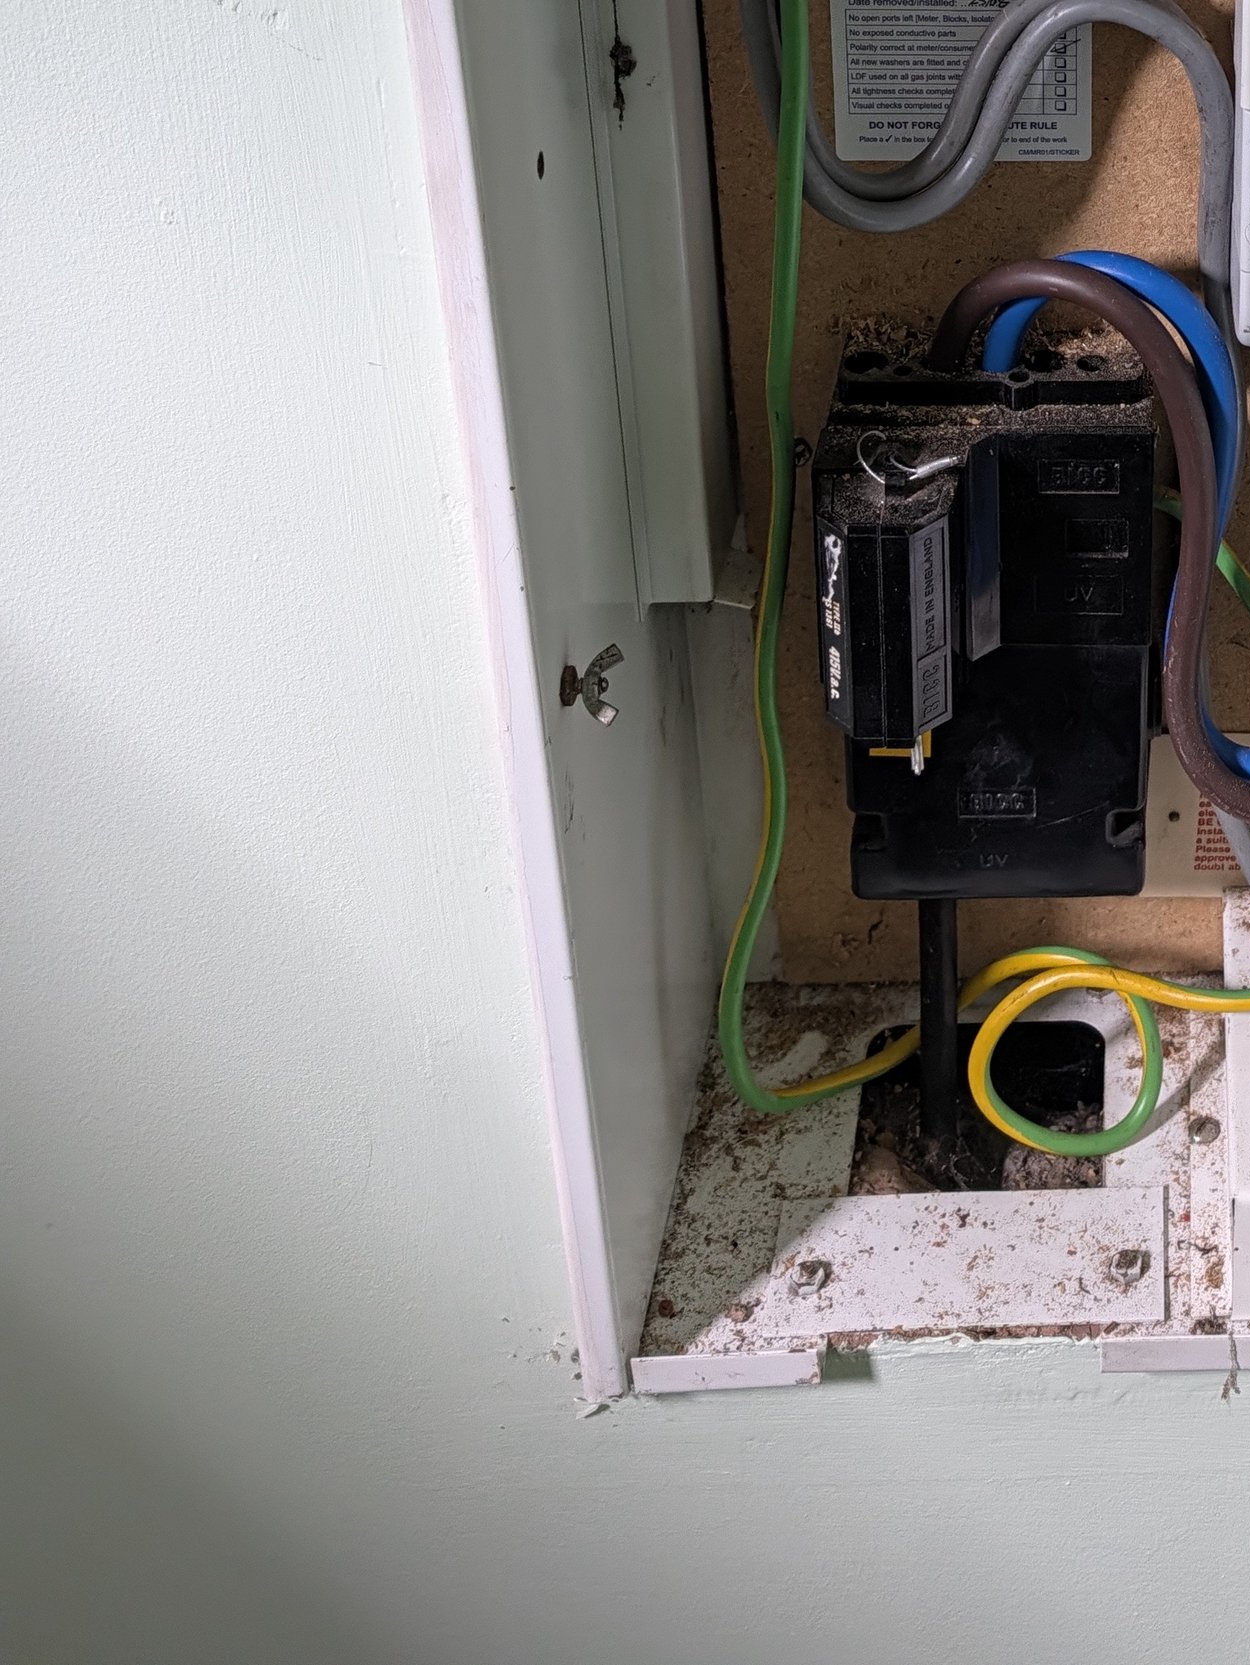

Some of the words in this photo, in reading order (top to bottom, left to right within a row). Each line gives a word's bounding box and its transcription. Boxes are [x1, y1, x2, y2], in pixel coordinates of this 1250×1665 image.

[849, 14, 859, 22] No
[861, 15, 880, 24] open
[882, 15, 901, 24] ports
[903, 14, 913, 22] left
[862, 30, 893, 38] exposed
[938, 30, 957, 38] parts
[850, 44, 878, 53] Polarity
[880, 44, 905, 52] correct
[879, 58, 910, 66] washers
[926, 58, 944, 66] fitted
[947, 58, 960, 66] and
[926, 73, 946, 82] joints
[863, 88, 896, 97] tightness
[899, 88, 923, 96] checks
[904, 102, 942, 111] completed
[869, 121, 885, 129] DO
[887, 121, 908, 129] NOT
[1030, 121, 1058, 130] RULE
[924, 537, 935, 596] ENGLAND
[925, 614, 936, 652] MADE
[1198, 818, 1213, 827] BE
[1194, 863, 1225, 871] doubt
